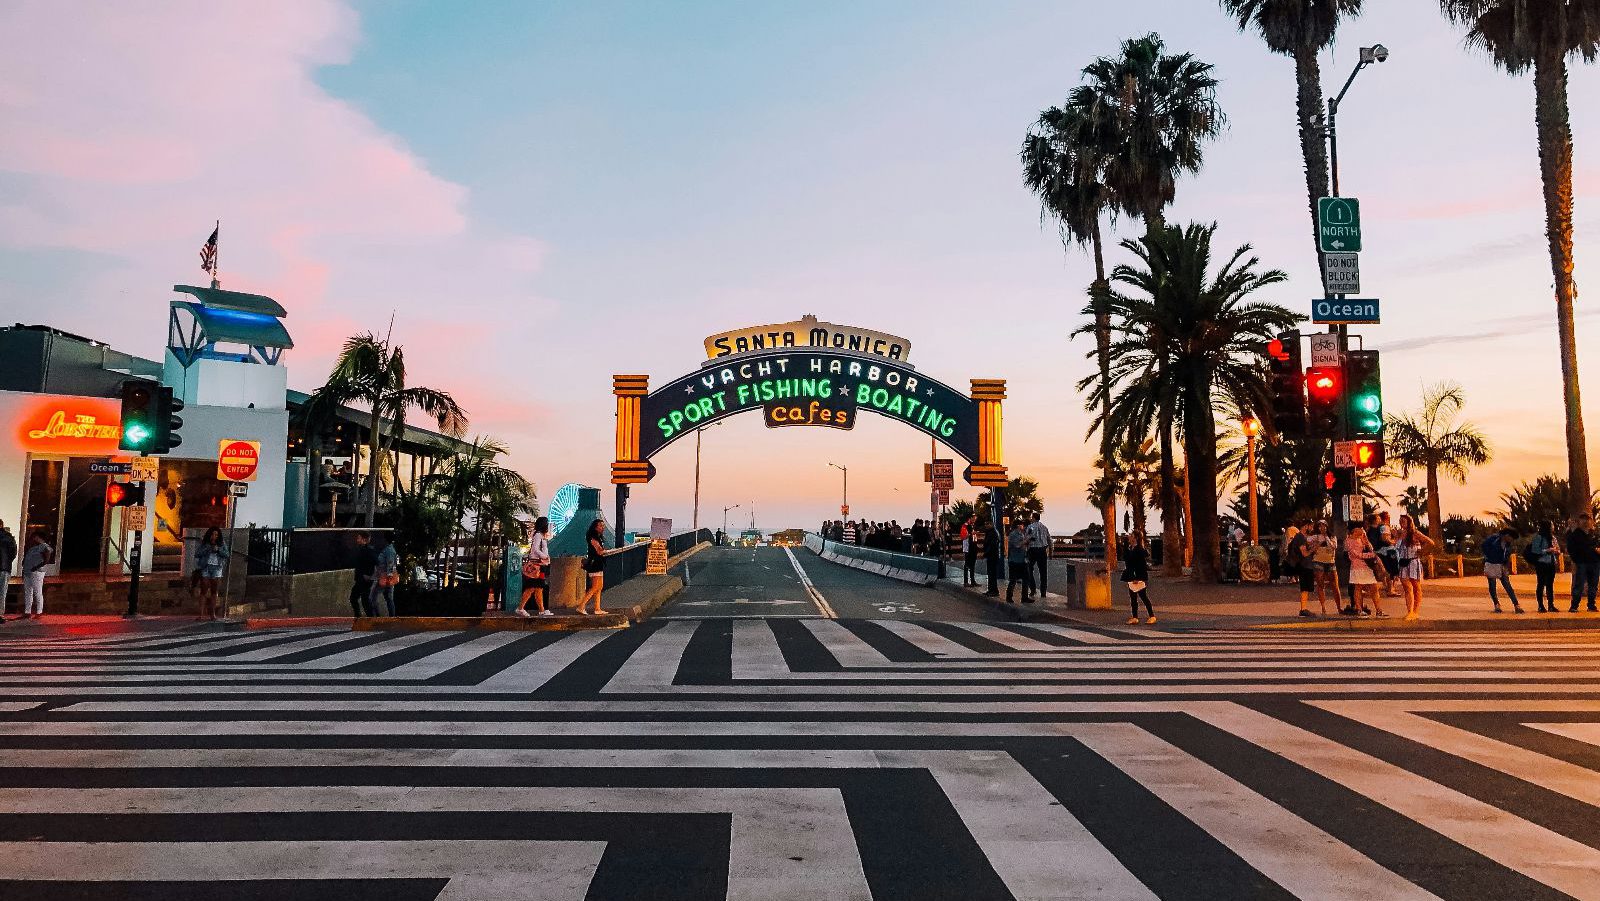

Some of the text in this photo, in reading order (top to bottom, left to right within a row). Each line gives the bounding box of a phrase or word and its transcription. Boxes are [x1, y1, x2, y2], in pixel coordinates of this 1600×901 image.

[1337, 207, 1342, 220] 1
[1322, 226, 1358, 237] NORTH
[1327, 258, 1357, 268] DO NOT
[1328, 271, 1357, 281] BLOCK
[1317, 302, 1375, 316] Ocean
[714, 328, 902, 360] SANTA MONICA
[1313, 355, 1337, 363] SIGNAL
[701, 358, 918, 393] YACHT HARBOR
[657, 378, 957, 438] SPORT FISHING BOATING
[771, 400, 848, 425] cafes
[75, 414, 96, 424] THE
[226, 448, 237, 456] DO
[90, 463, 119, 472] Ocean
